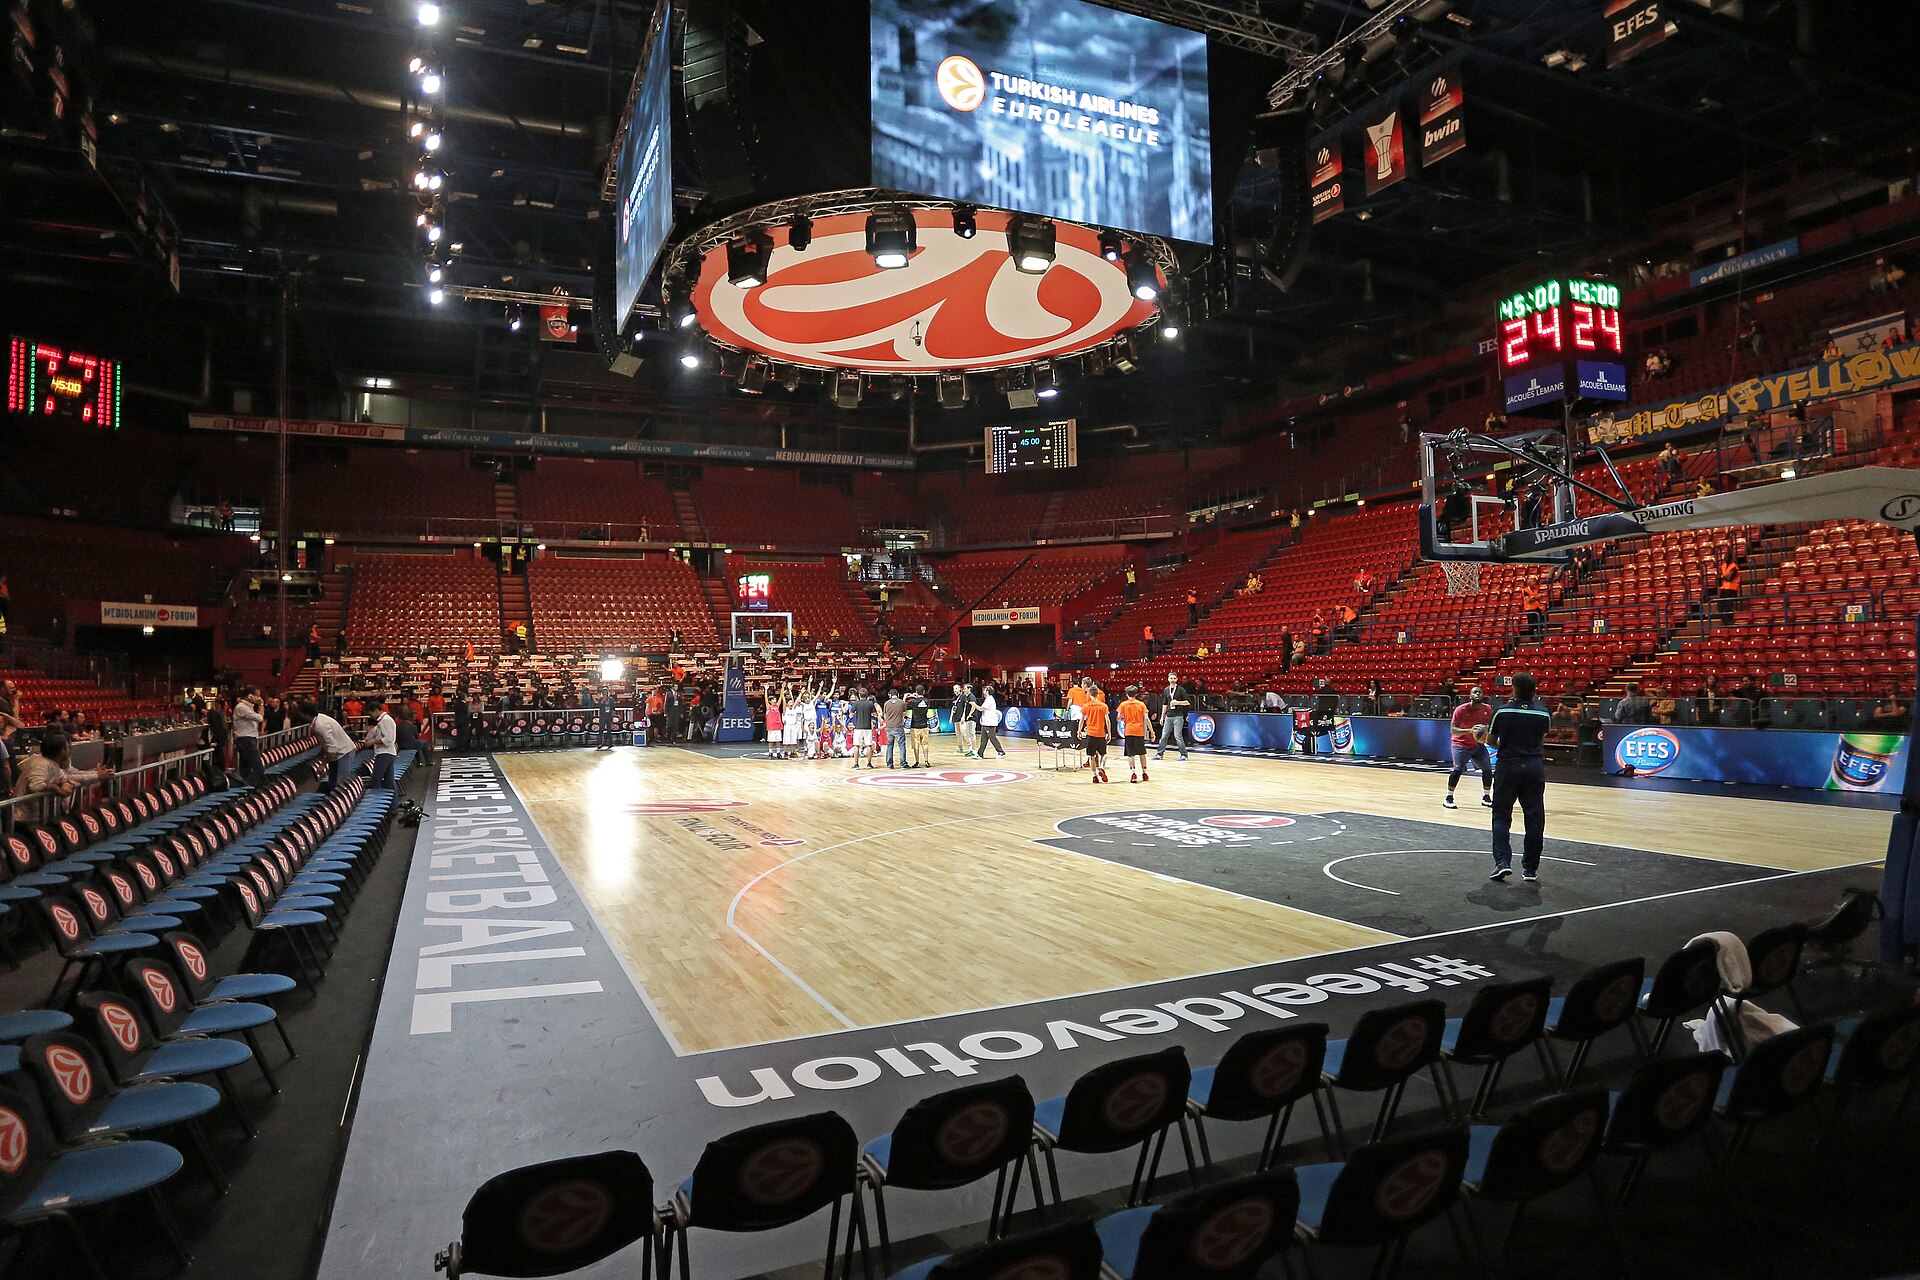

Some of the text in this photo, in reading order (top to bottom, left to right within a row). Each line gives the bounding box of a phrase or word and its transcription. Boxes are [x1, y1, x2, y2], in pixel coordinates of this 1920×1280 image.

[1613, 3, 1658, 42] EFES
[990, 71, 1159, 125] TURKISH AIRLINES
[992, 96, 1159, 147] EUROLEAGUE
[1424, 118, 1460, 147] bwin
[1501, 279, 1560, 320] 45:00
[1569, 279, 1618, 307] 45:00
[1506, 307, 1561, 363] 24
[1574, 305, 1621, 351] 24
[52, 377, 82, 393] 45:00
[1506, 382, 1564, 405] JACQUES LEMANS
[1579, 381, 1626, 392] JACQUES LEMANS
[775, 451, 863, 464] MEDIOLANUMFORUM.IT
[1632, 501, 1694, 523] SPALDING
[1535, 522, 1589, 544] SPALDING
[748, 583, 768, 597] 24
[104, 608, 195, 621] MEDIOLANUM FORUM
[974, 611, 1038, 621] MEDIOLANUM FORUM
[1785, 675, 1796, 684] 22
[722, 718, 752, 729] EFES
[1195, 722, 1211, 732] EFES
[1332, 726, 1350, 740] EFES
[1626, 740, 1669, 759] EFES
[1839, 750, 1882, 775] EFES
[409, 805, 604, 1036] BASKETBALL
